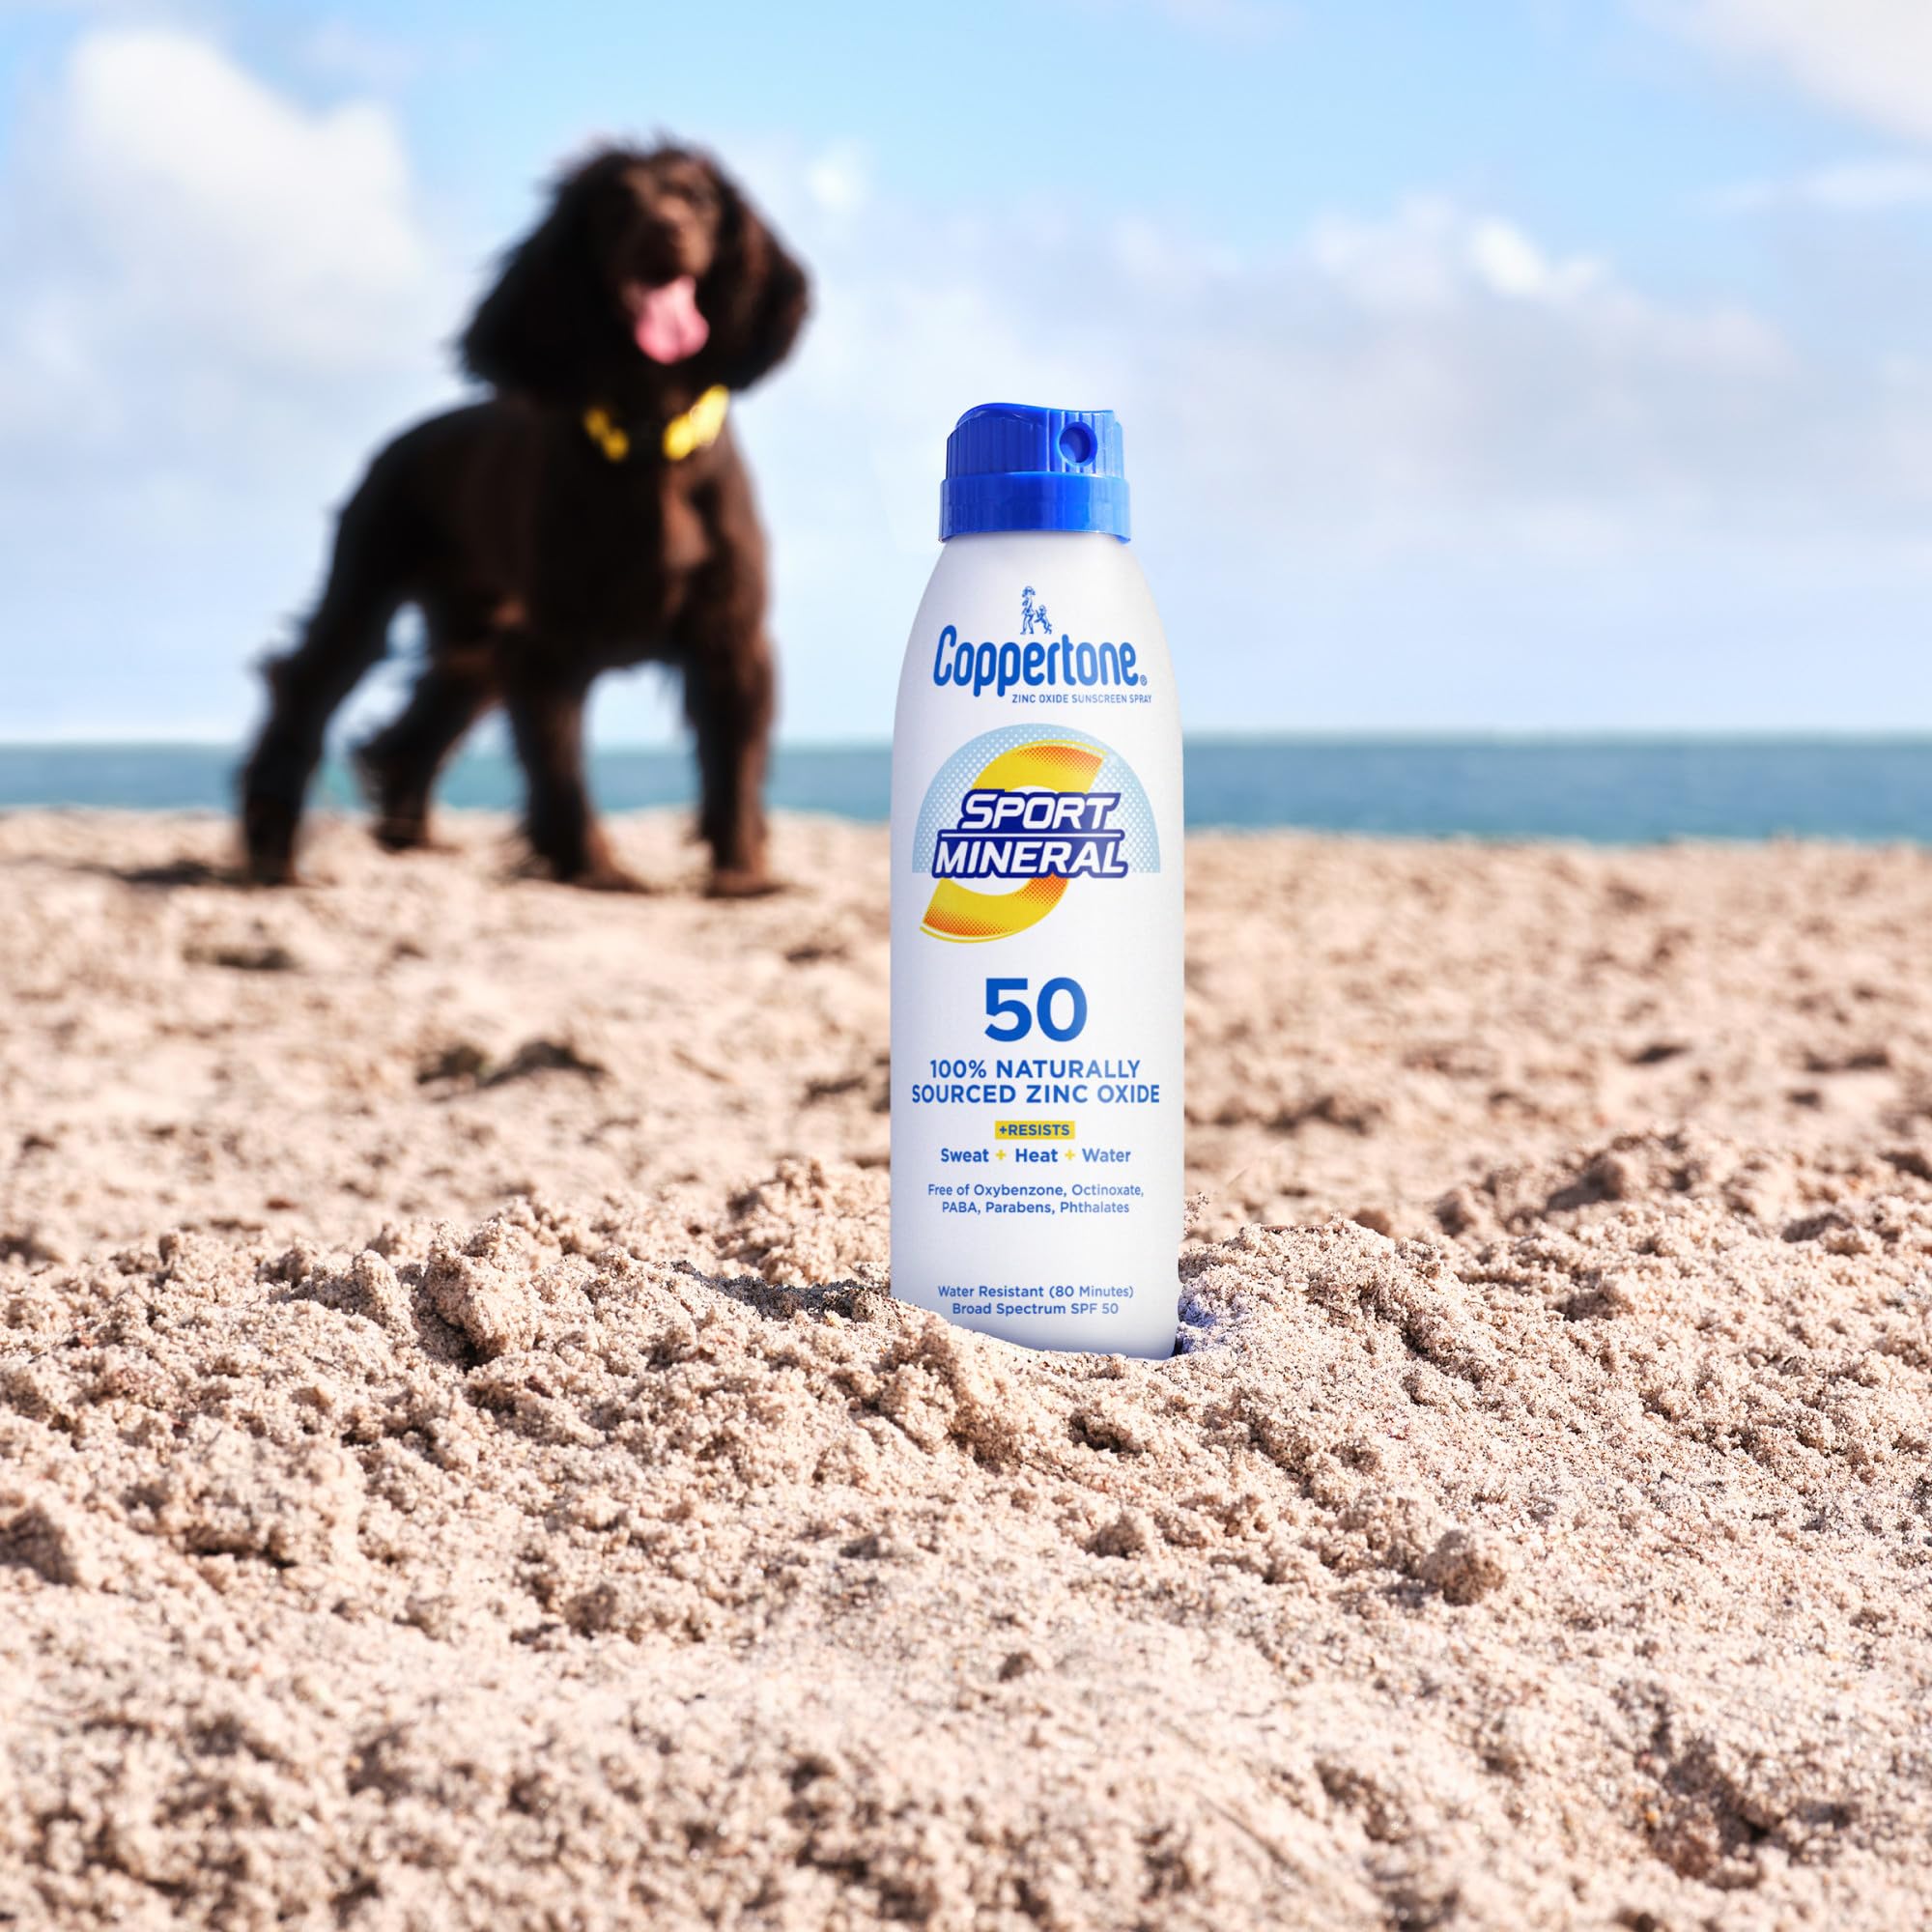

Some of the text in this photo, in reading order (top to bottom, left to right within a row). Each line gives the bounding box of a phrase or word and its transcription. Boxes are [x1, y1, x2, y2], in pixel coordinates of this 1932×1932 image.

[1011, 694, 1151, 704] ZINC OXIDE SUNSCREEN SPRAY
[962, 793, 1118, 830] SPORT
[935, 840, 1126, 874] MINERAL
[984, 977, 1088, 1042] 50
[930, 1059, 1141, 1079] 100% NATURALLY
[912, 1084, 1160, 1104] SOURCED ZINC OXIDE
[999, 1123, 1070, 1137] +RESISTS
[940, 1148, 990, 1164] Sweat
[1015, 1148, 1059, 1164] Heat
[1082, 1148, 1131, 1164] Water
[927, 1183, 1145, 1199] Free of Oxybenzone, Octinoxate,
[942, 1201, 1130, 1215] PABA, Parabens, Phthalates
[938, 1285, 1135, 1299] Water Resistant (80 Minutes)
[952, 1302, 1120, 1317] Broad Spectrum SPF 50
